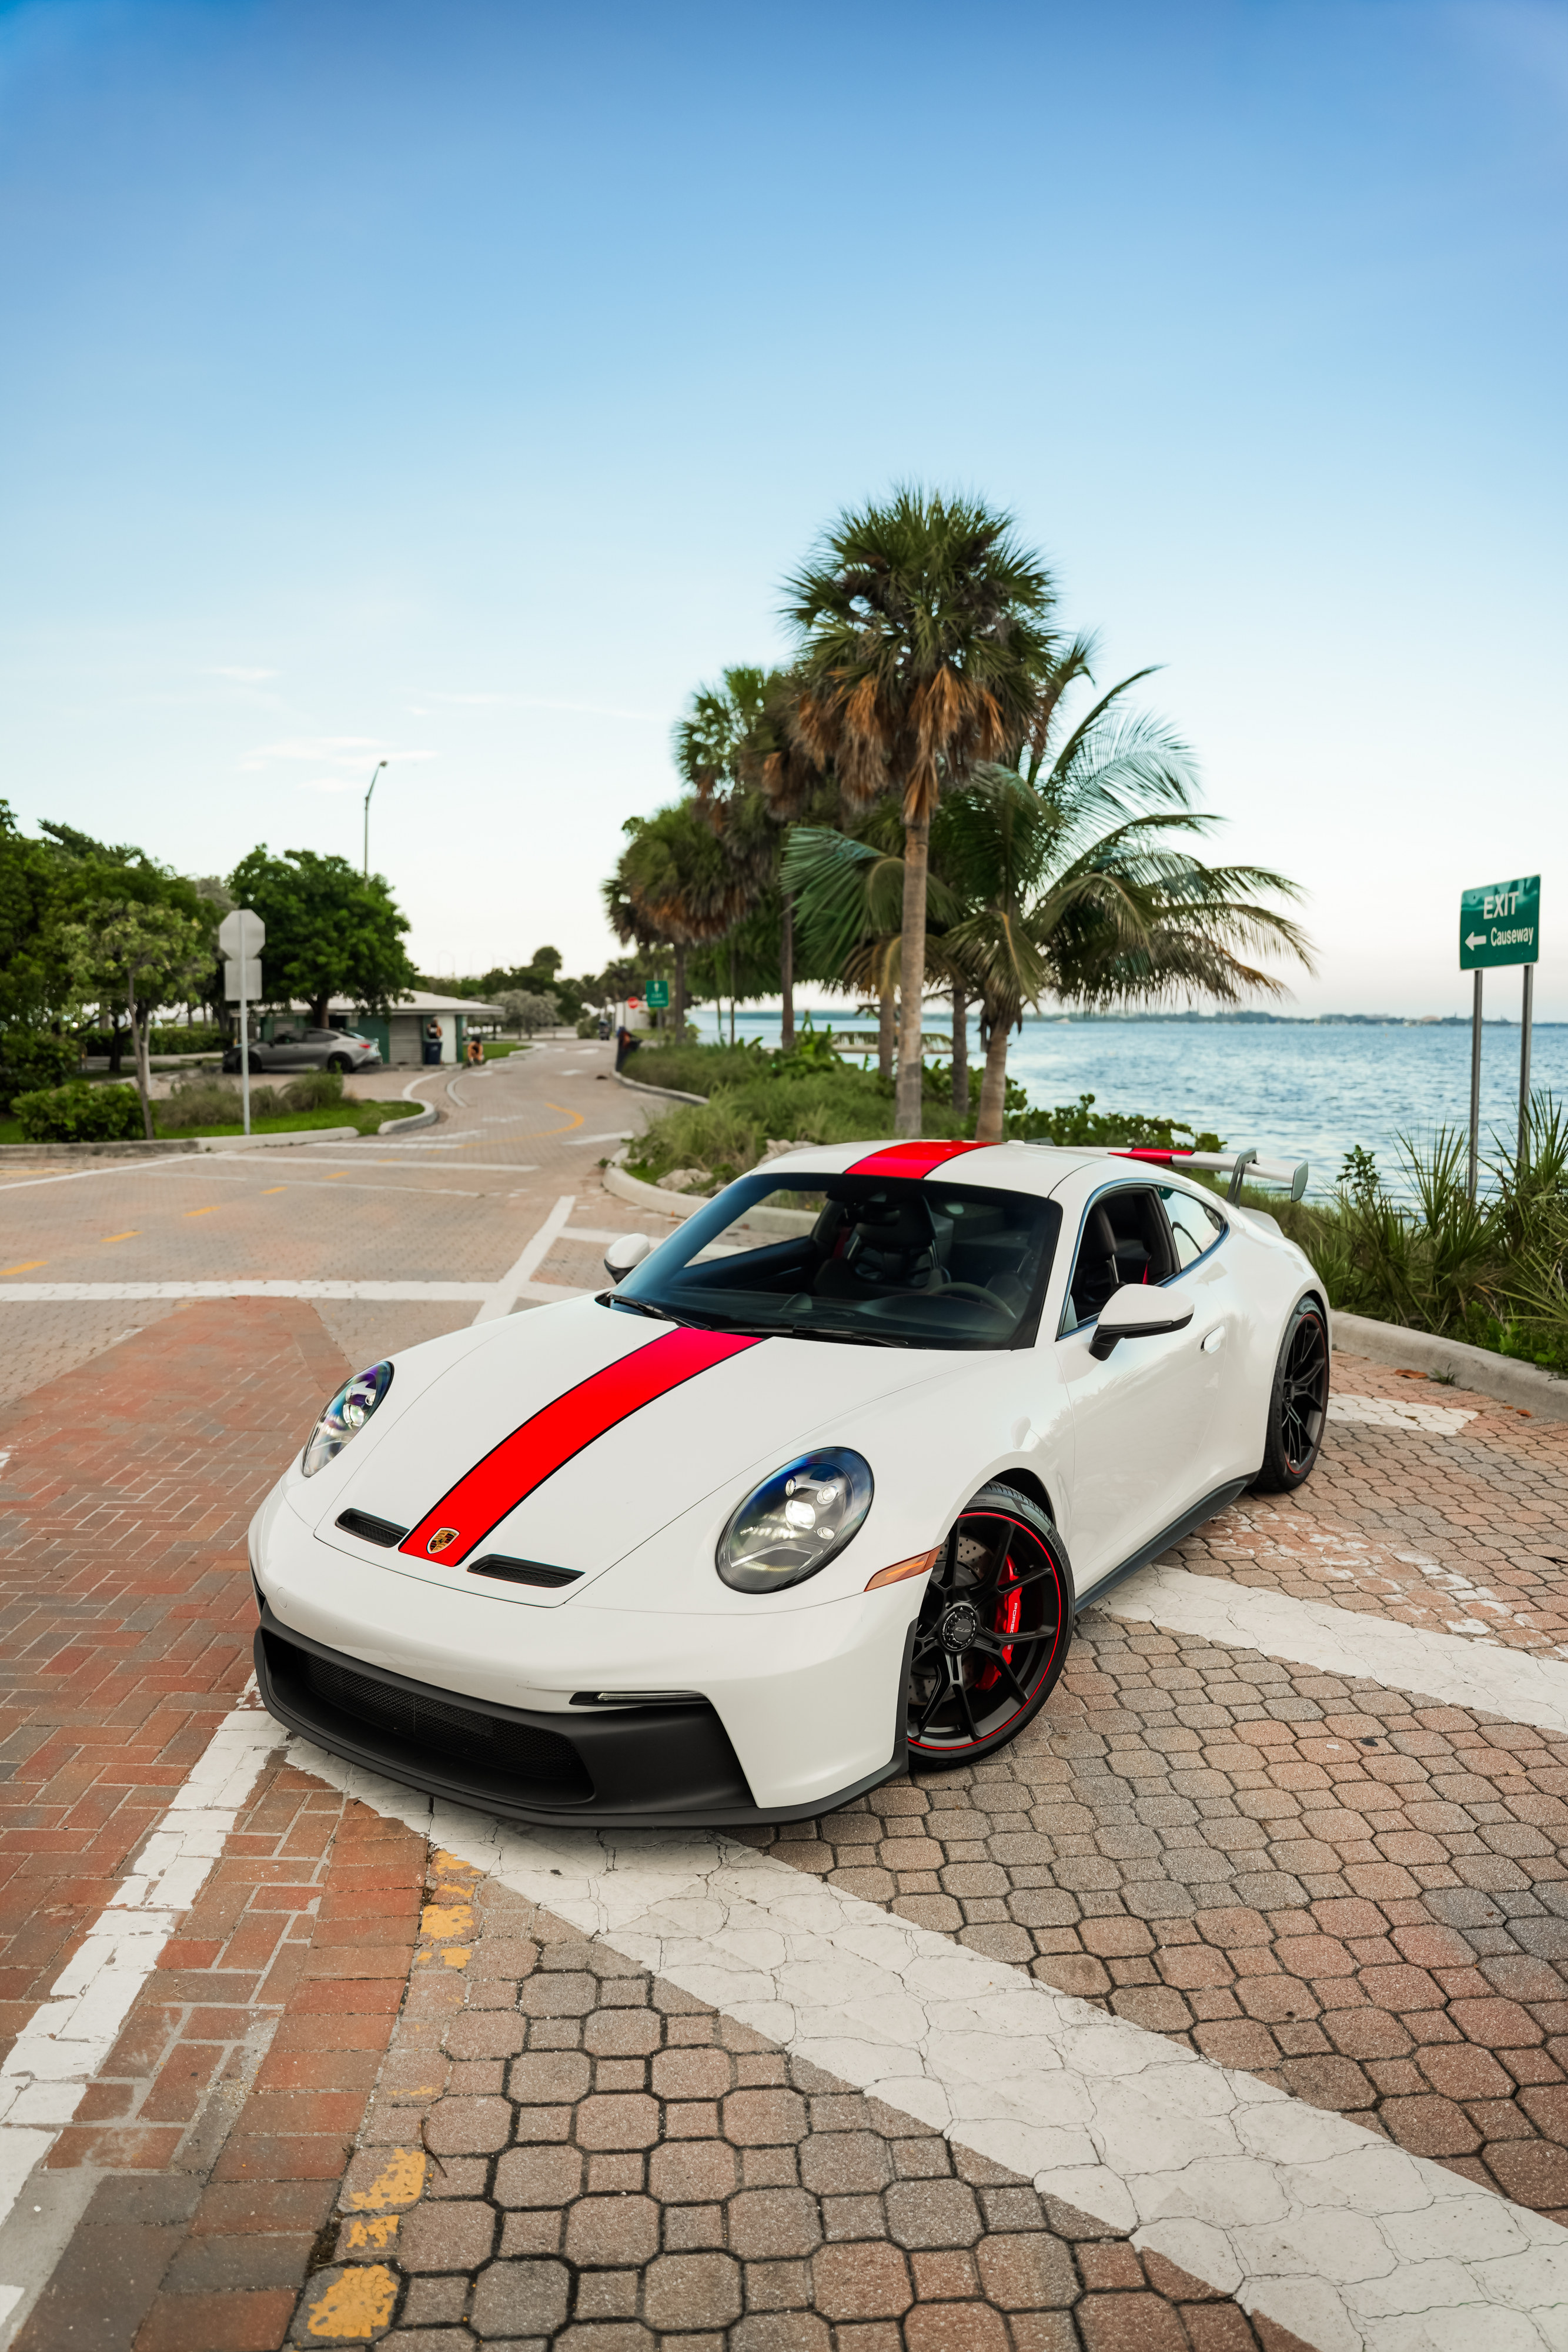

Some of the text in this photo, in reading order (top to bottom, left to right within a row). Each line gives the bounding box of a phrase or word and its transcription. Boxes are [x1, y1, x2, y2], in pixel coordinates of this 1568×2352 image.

[1483, 891, 1519, 920] EXIT
[1490, 927, 1534, 947] Causeway
[1047, 1527, 1066, 1564] PIRELLI
